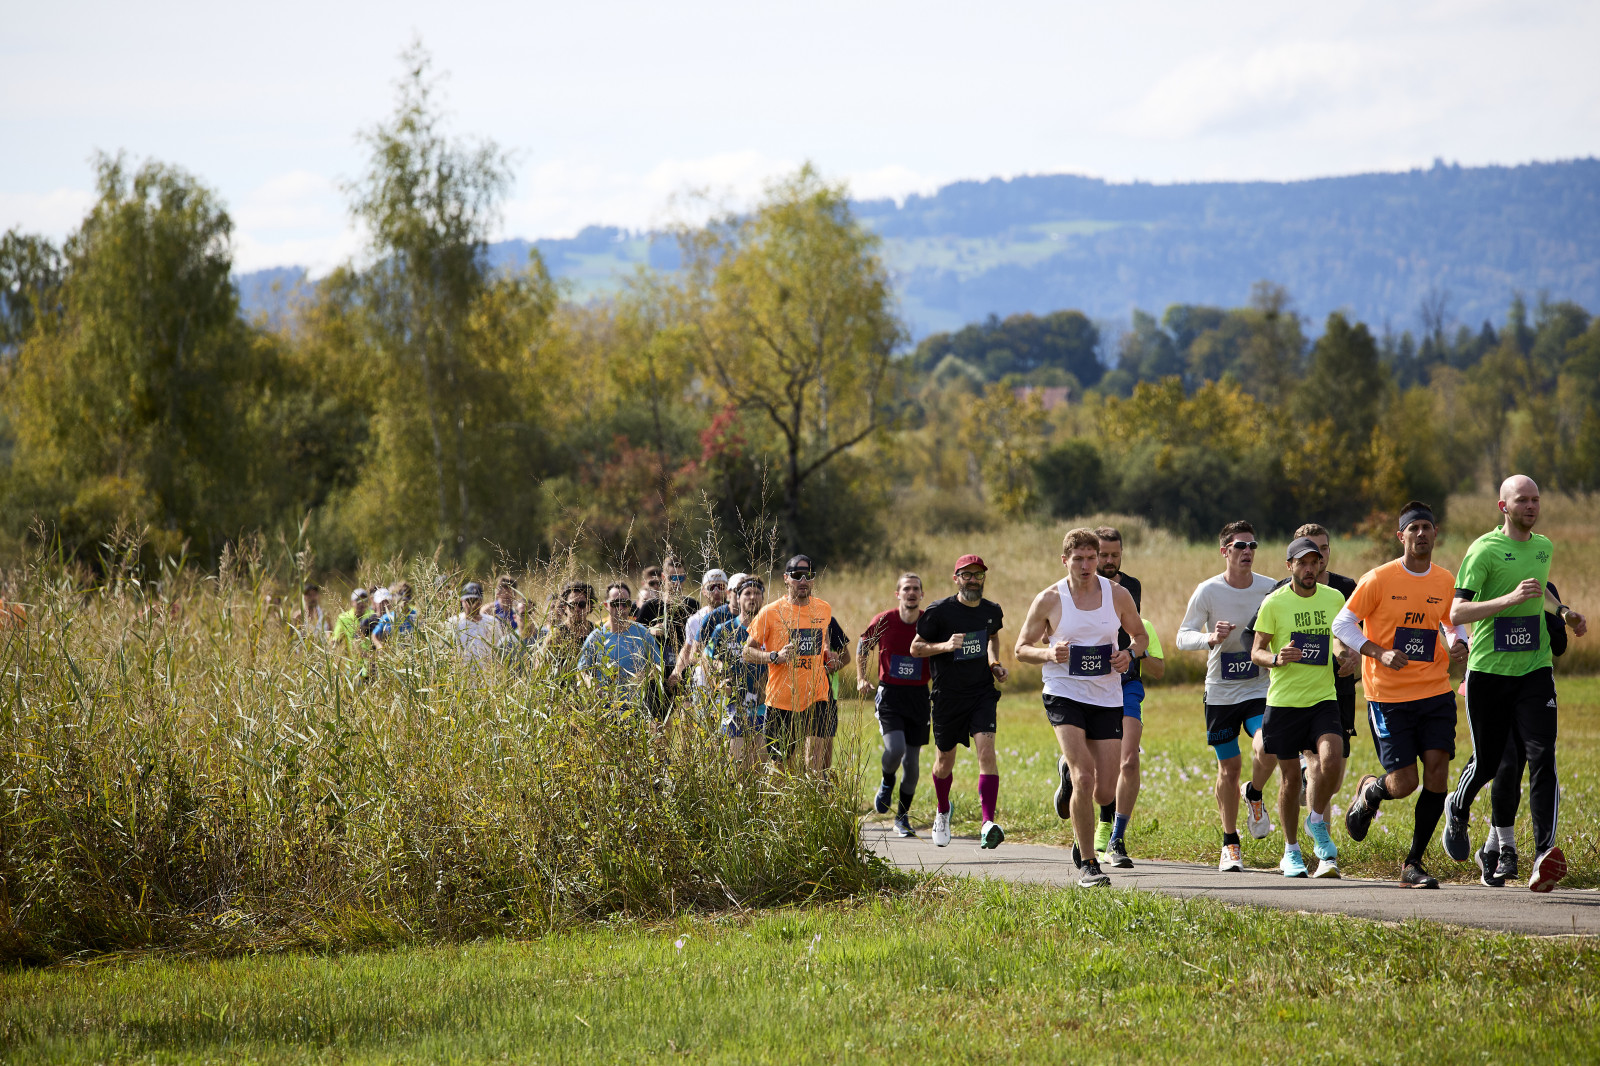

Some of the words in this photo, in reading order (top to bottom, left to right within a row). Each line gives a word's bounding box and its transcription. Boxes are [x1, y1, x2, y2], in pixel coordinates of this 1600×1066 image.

[1294, 611, 1311, 627] RIO
[1314, 610, 1327, 626] DE
[1404, 612, 1425, 624] FIN
[1504, 633, 1532, 645] 1082
[800, 641, 813, 651] 617
[962, 644, 981, 655] 1788
[1404, 643, 1425, 655] 994
[1302, 648, 1320, 659] 577
[898, 666, 914, 675] 339
[1080, 661, 1102, 671] 334
[1228, 660, 1252, 673] 2197
